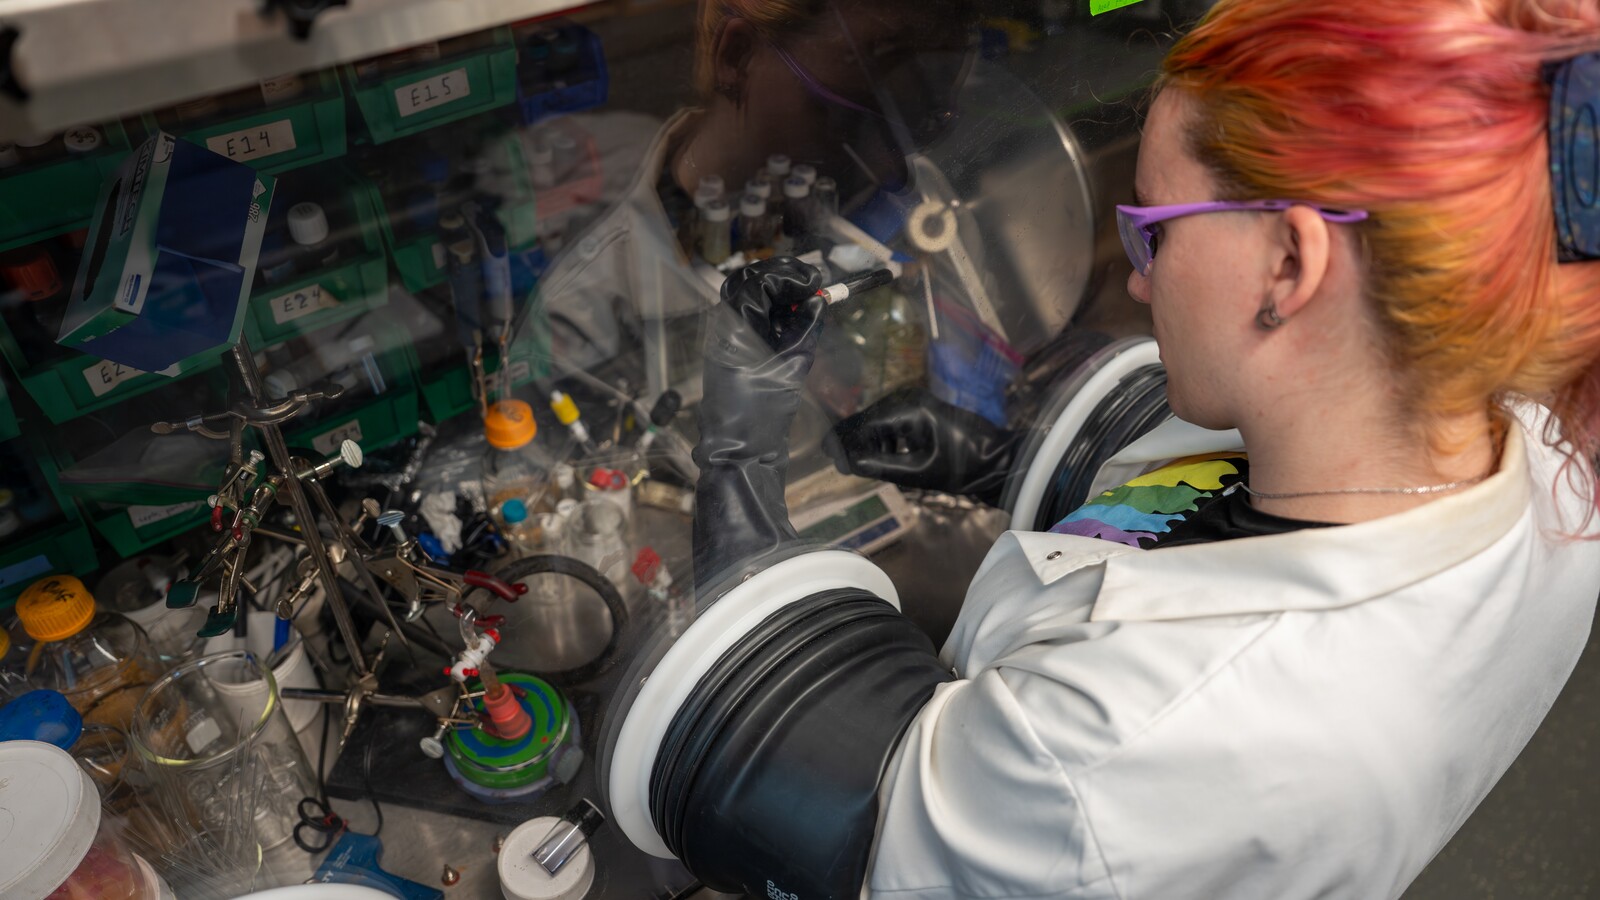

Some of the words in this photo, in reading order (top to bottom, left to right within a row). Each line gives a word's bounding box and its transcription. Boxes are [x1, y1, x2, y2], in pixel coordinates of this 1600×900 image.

[411, 76, 452, 107] E15
[226, 131, 271, 157] E14
[248, 202, 261, 223] 286
[283, 289, 321, 313] E24
